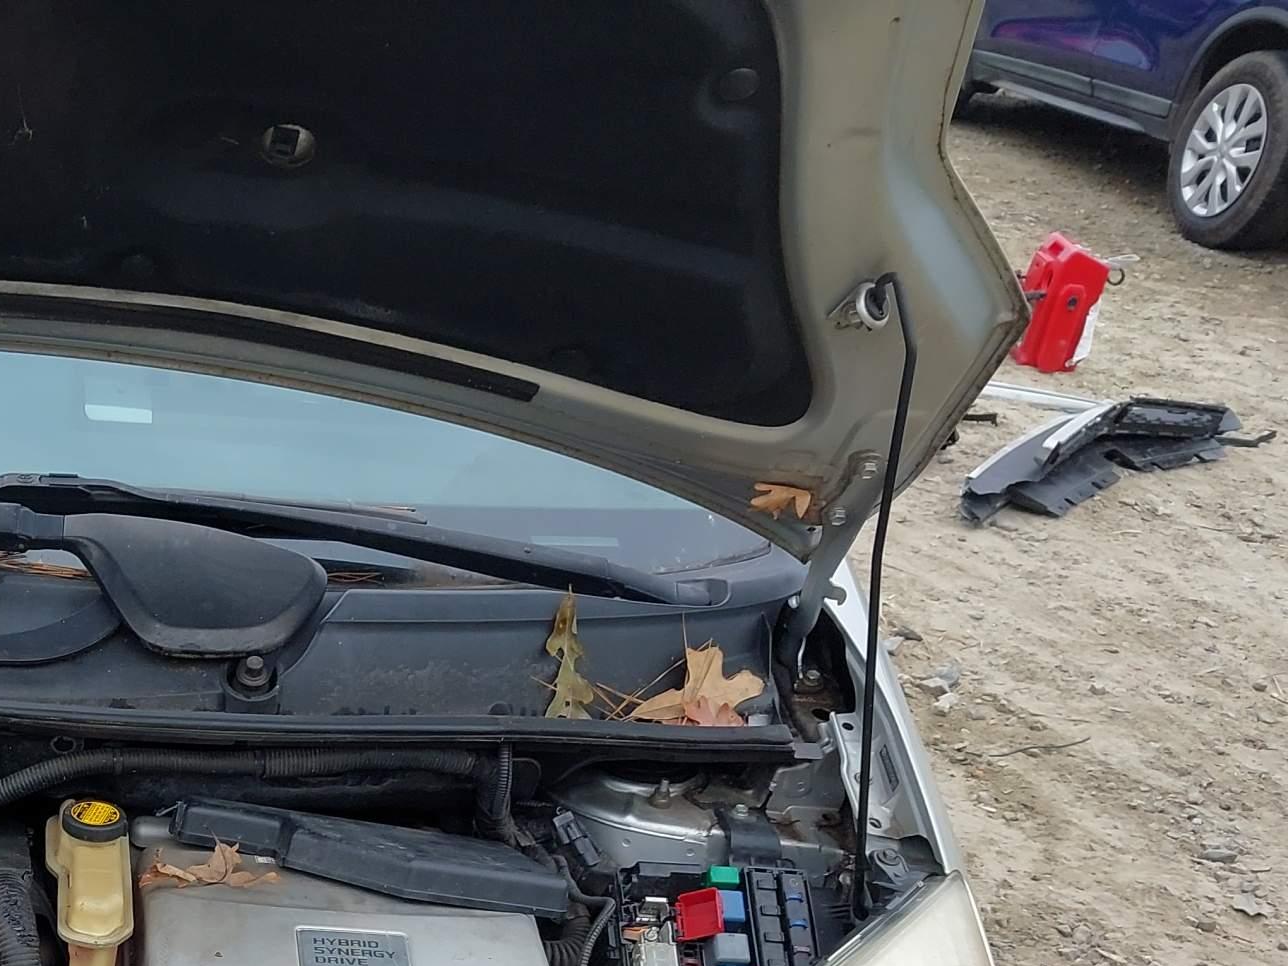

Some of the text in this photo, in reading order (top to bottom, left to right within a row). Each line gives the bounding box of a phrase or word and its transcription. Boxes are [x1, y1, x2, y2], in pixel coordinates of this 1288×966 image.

[313, 937, 379, 949] HYBRID
[314, 947, 396, 960] SYNERGY
[315, 956, 369, 966] DRIVE
